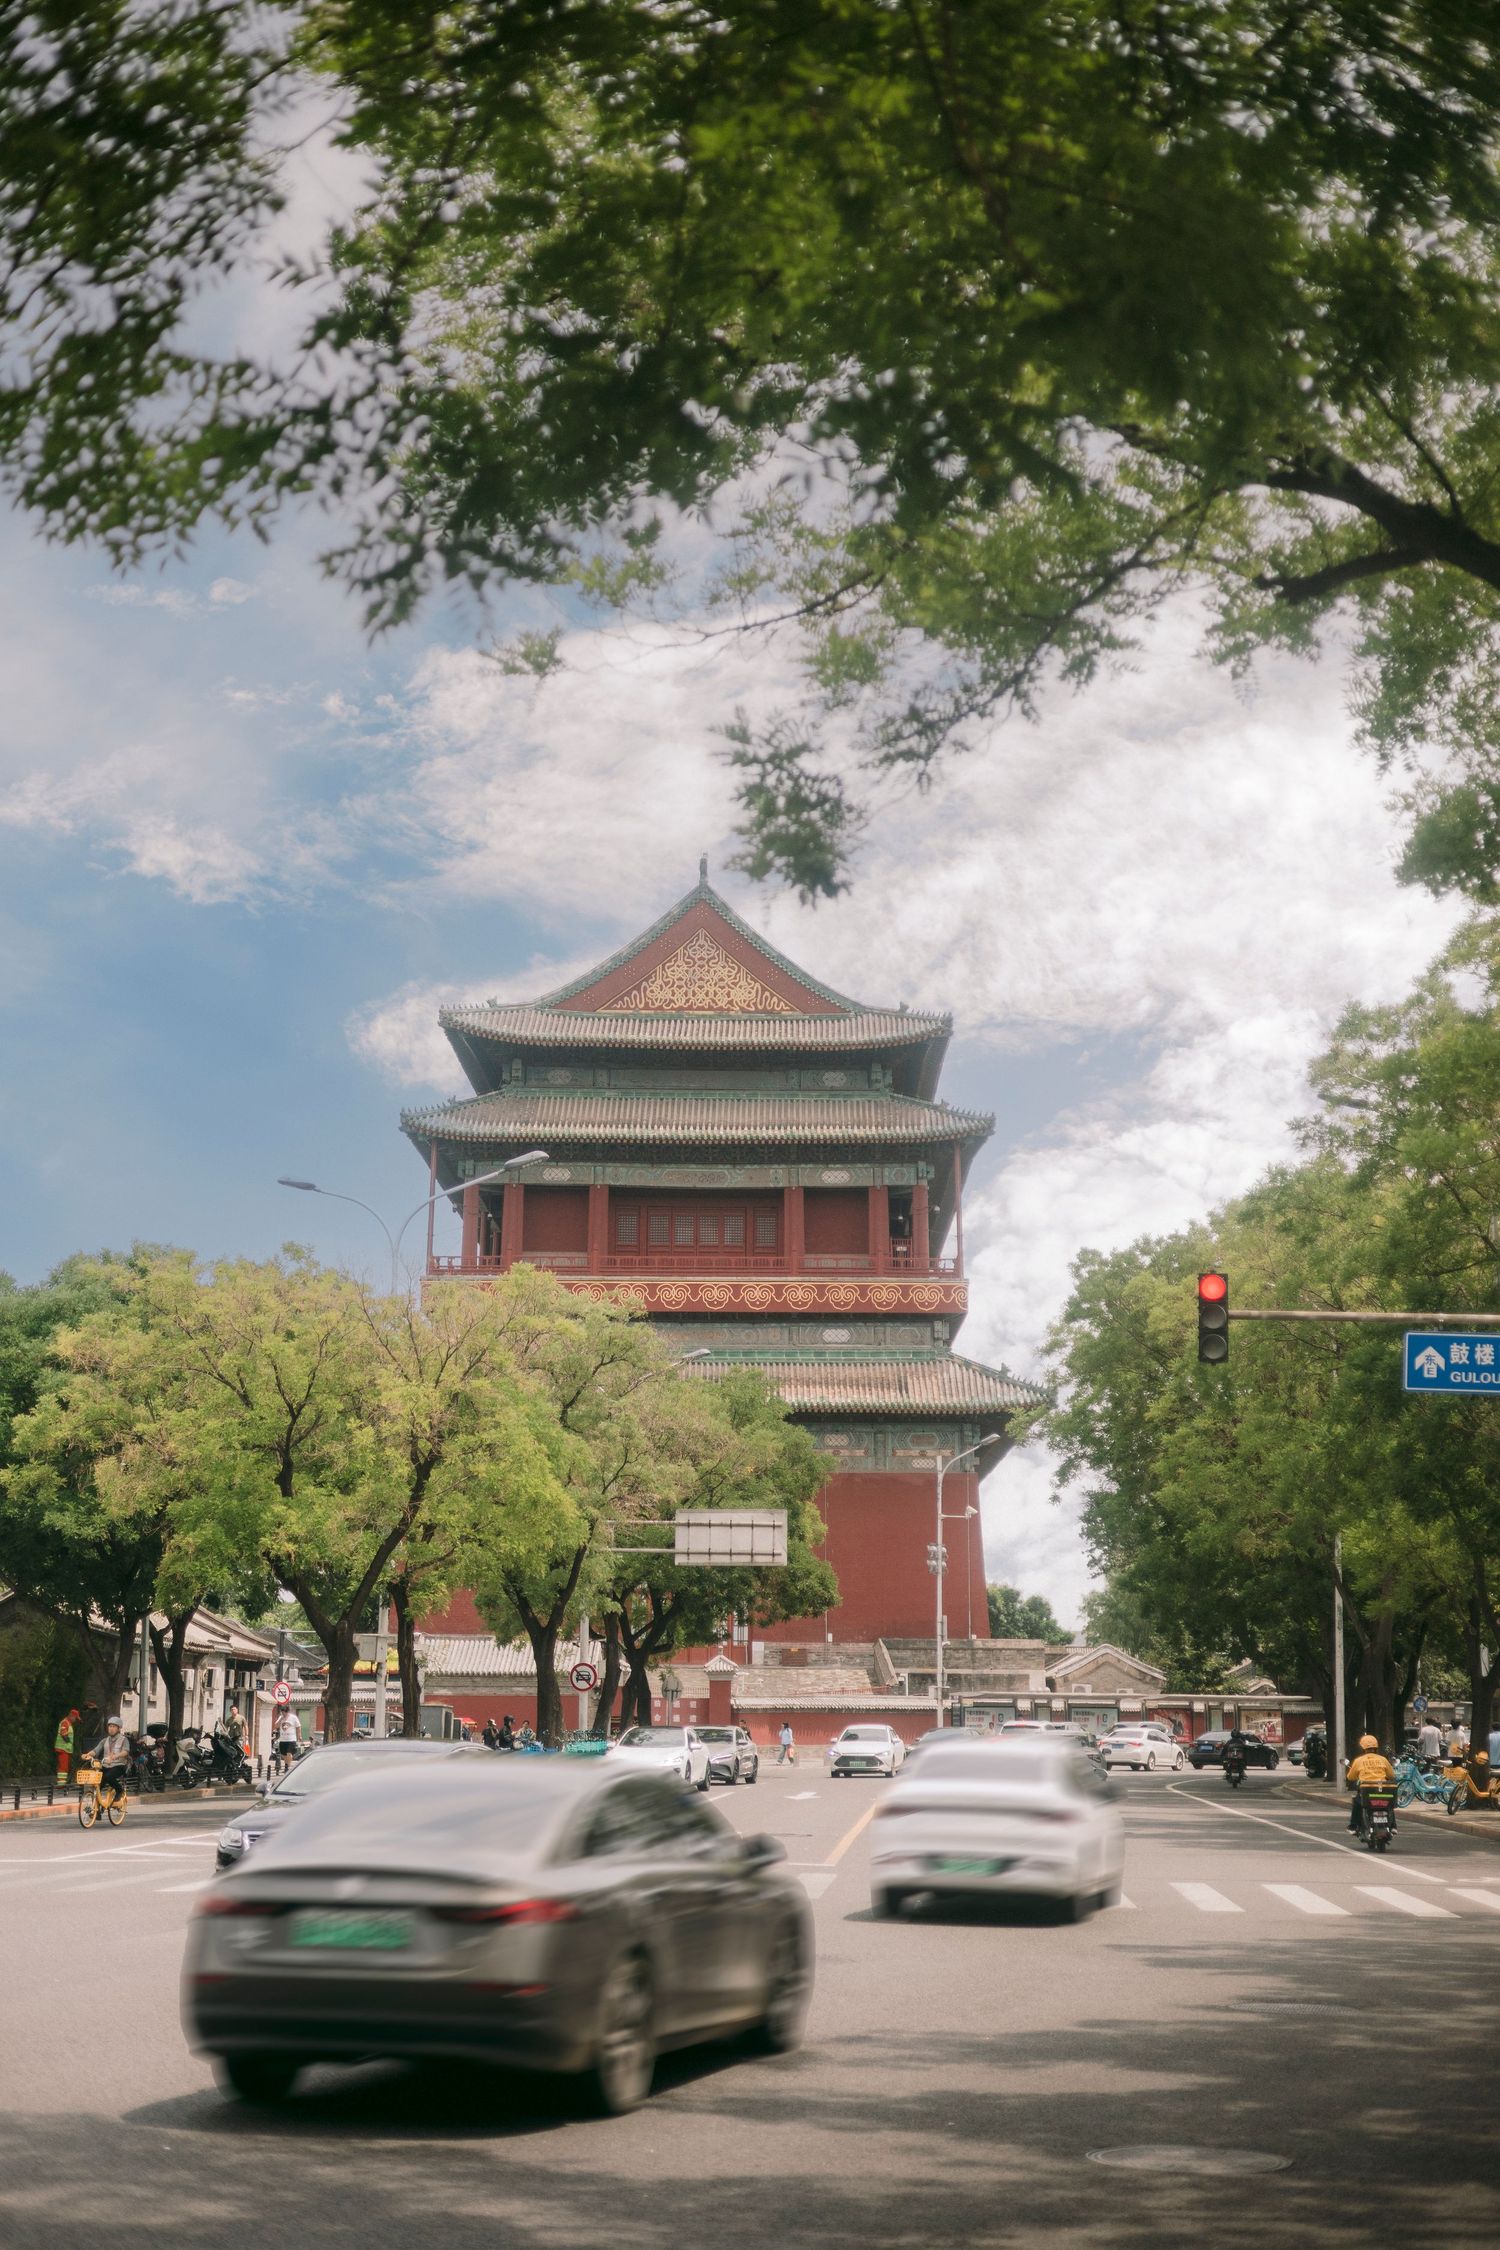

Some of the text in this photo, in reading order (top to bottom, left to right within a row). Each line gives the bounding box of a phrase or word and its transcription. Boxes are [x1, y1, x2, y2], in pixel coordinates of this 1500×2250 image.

[1424, 1354, 1437, 1366] 东
[1450, 1342, 1495, 1366] 鼓楼
[1427, 1367, 1435, 1376] E
[1450, 1371, 1500, 1384] GULOU
